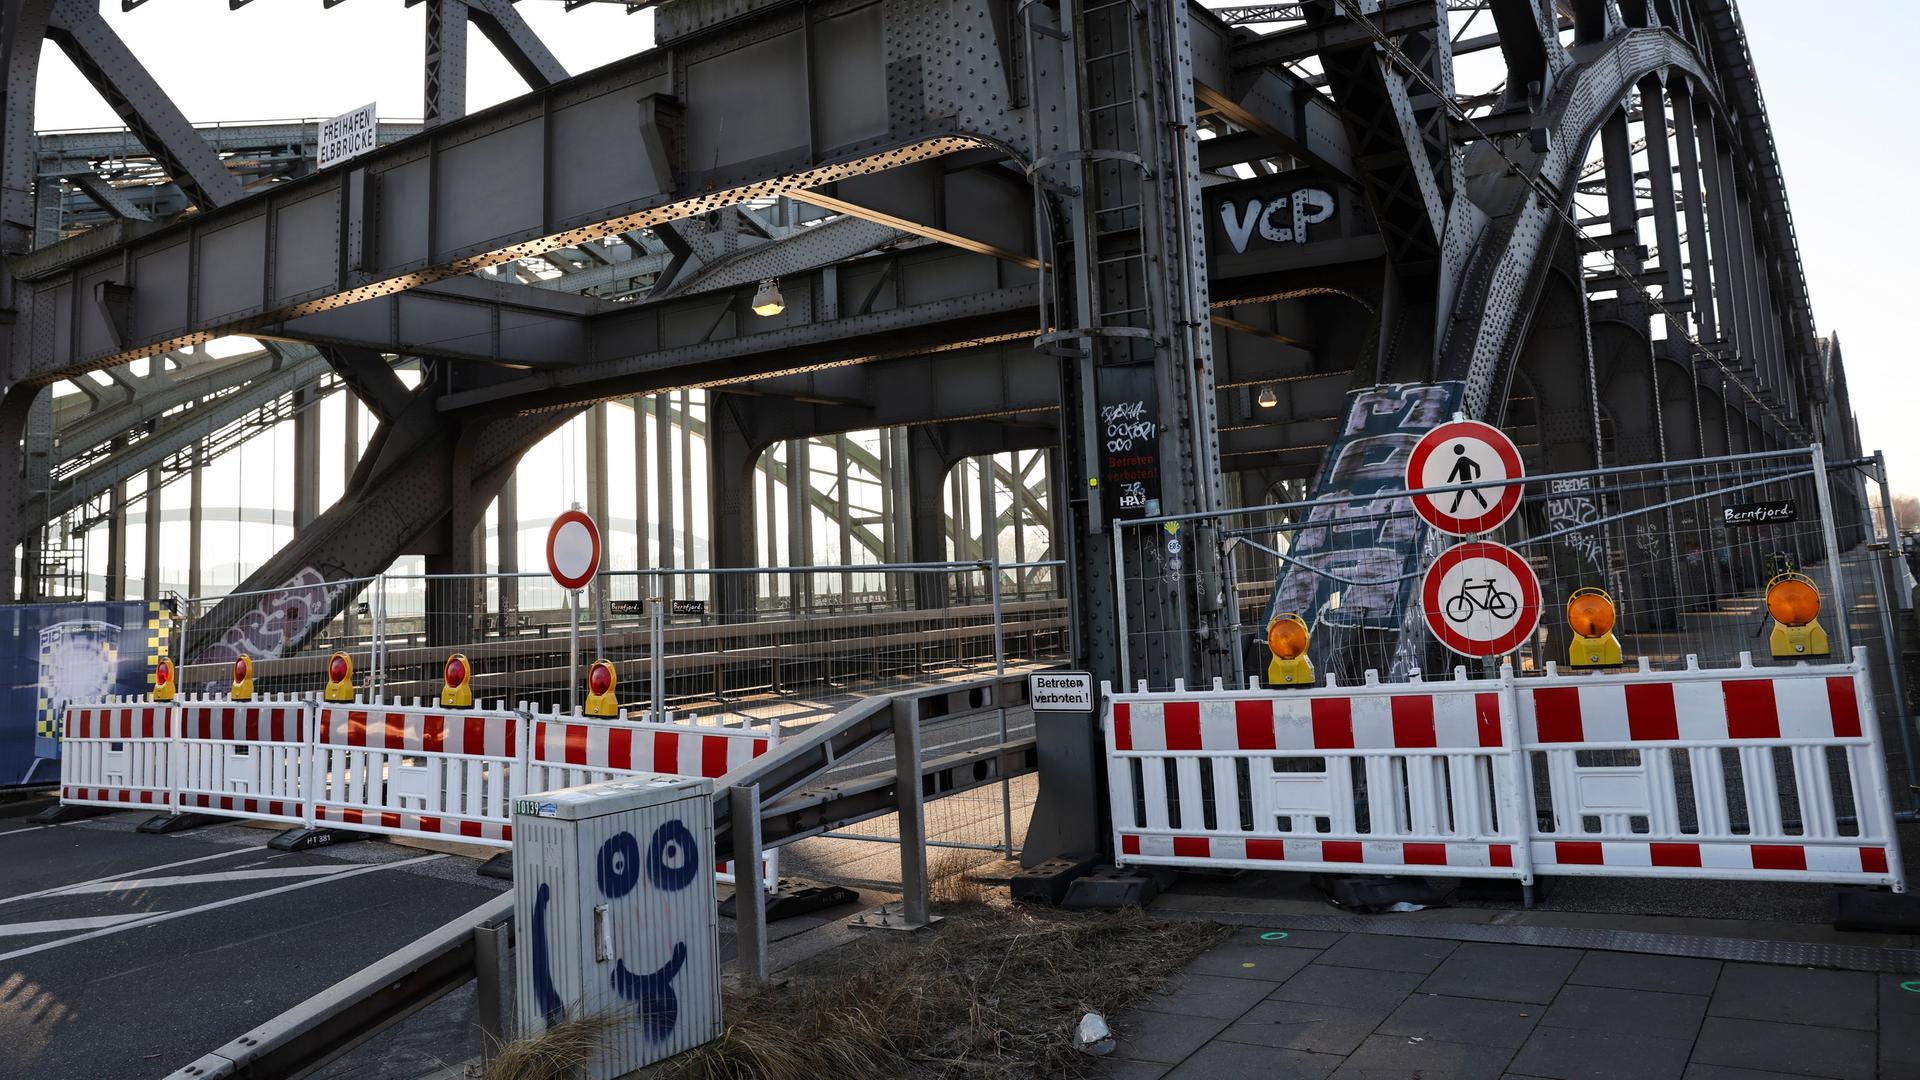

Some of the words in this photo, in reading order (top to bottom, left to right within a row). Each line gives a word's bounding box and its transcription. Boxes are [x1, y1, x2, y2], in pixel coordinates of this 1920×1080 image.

[323, 109, 370, 143] FREIHAFEN
[321, 128, 373, 163] ELBBRÜCKE
[1220, 188, 1335, 254] VCP
[1108, 455, 1153, 468] Betreten
[1037, 677, 1084, 688] Betreten
[516, 800, 539, 815] 10139
